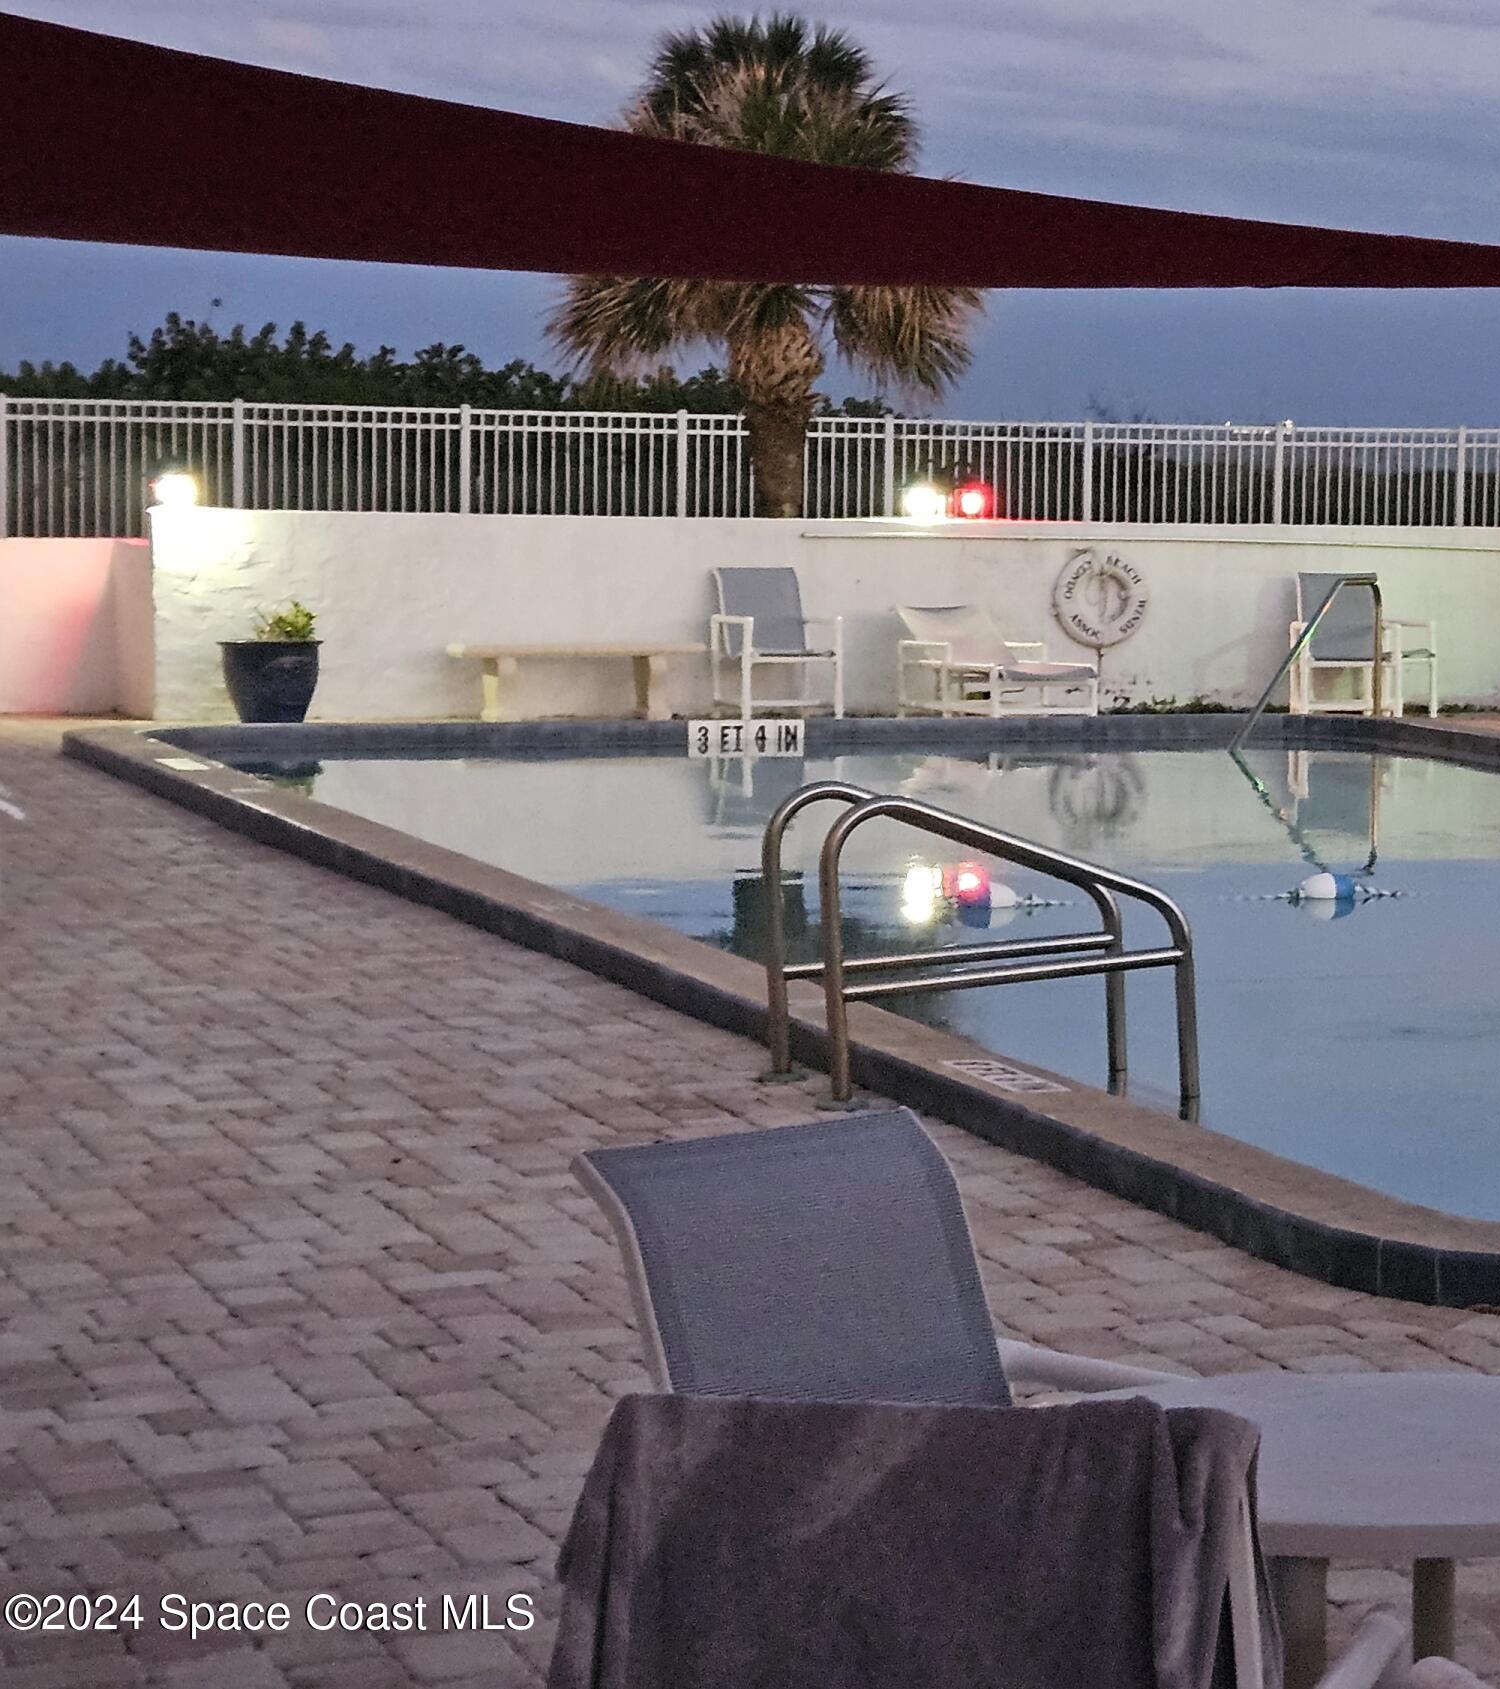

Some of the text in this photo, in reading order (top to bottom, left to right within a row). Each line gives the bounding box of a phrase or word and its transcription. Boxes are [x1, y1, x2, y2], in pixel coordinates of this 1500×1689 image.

[1063, 560, 1092, 600] CONDO
[1106, 555, 1147, 634] BEACH WINDS
[697, 725, 709, 741] 3
[755, 725, 767, 741] 4
[777, 725, 799, 741] IN
